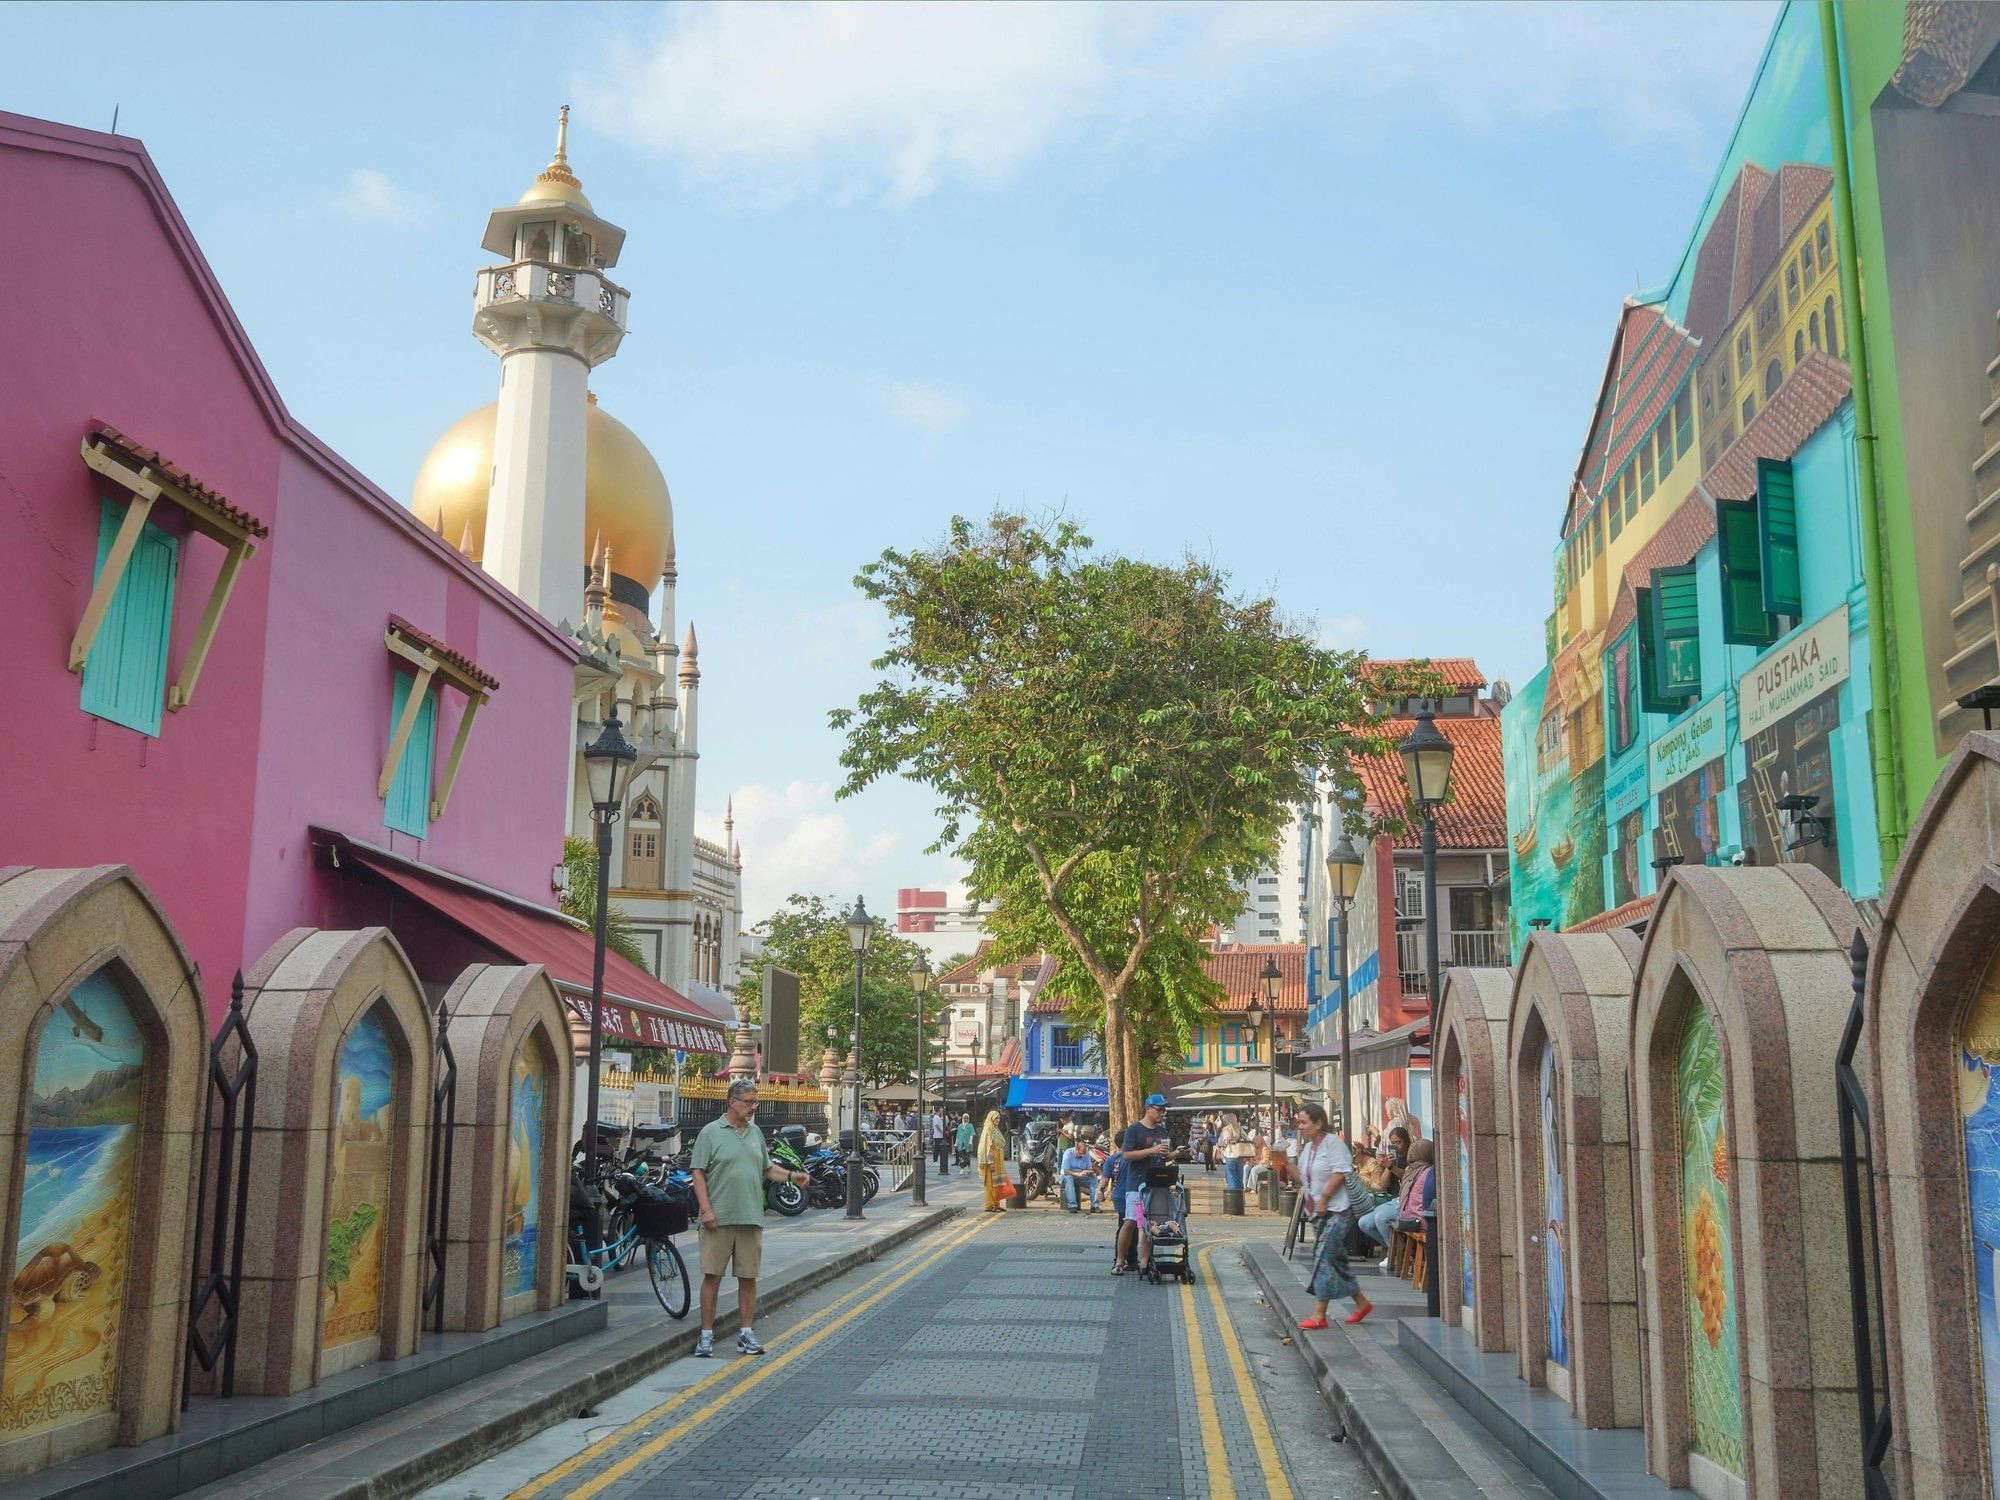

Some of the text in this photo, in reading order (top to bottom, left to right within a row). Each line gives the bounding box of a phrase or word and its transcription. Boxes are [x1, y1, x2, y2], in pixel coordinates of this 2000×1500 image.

[1749, 657, 1838, 725] HAJI MUHAMMAD SAID
[1757, 637, 1820, 701] PUSTAKA
